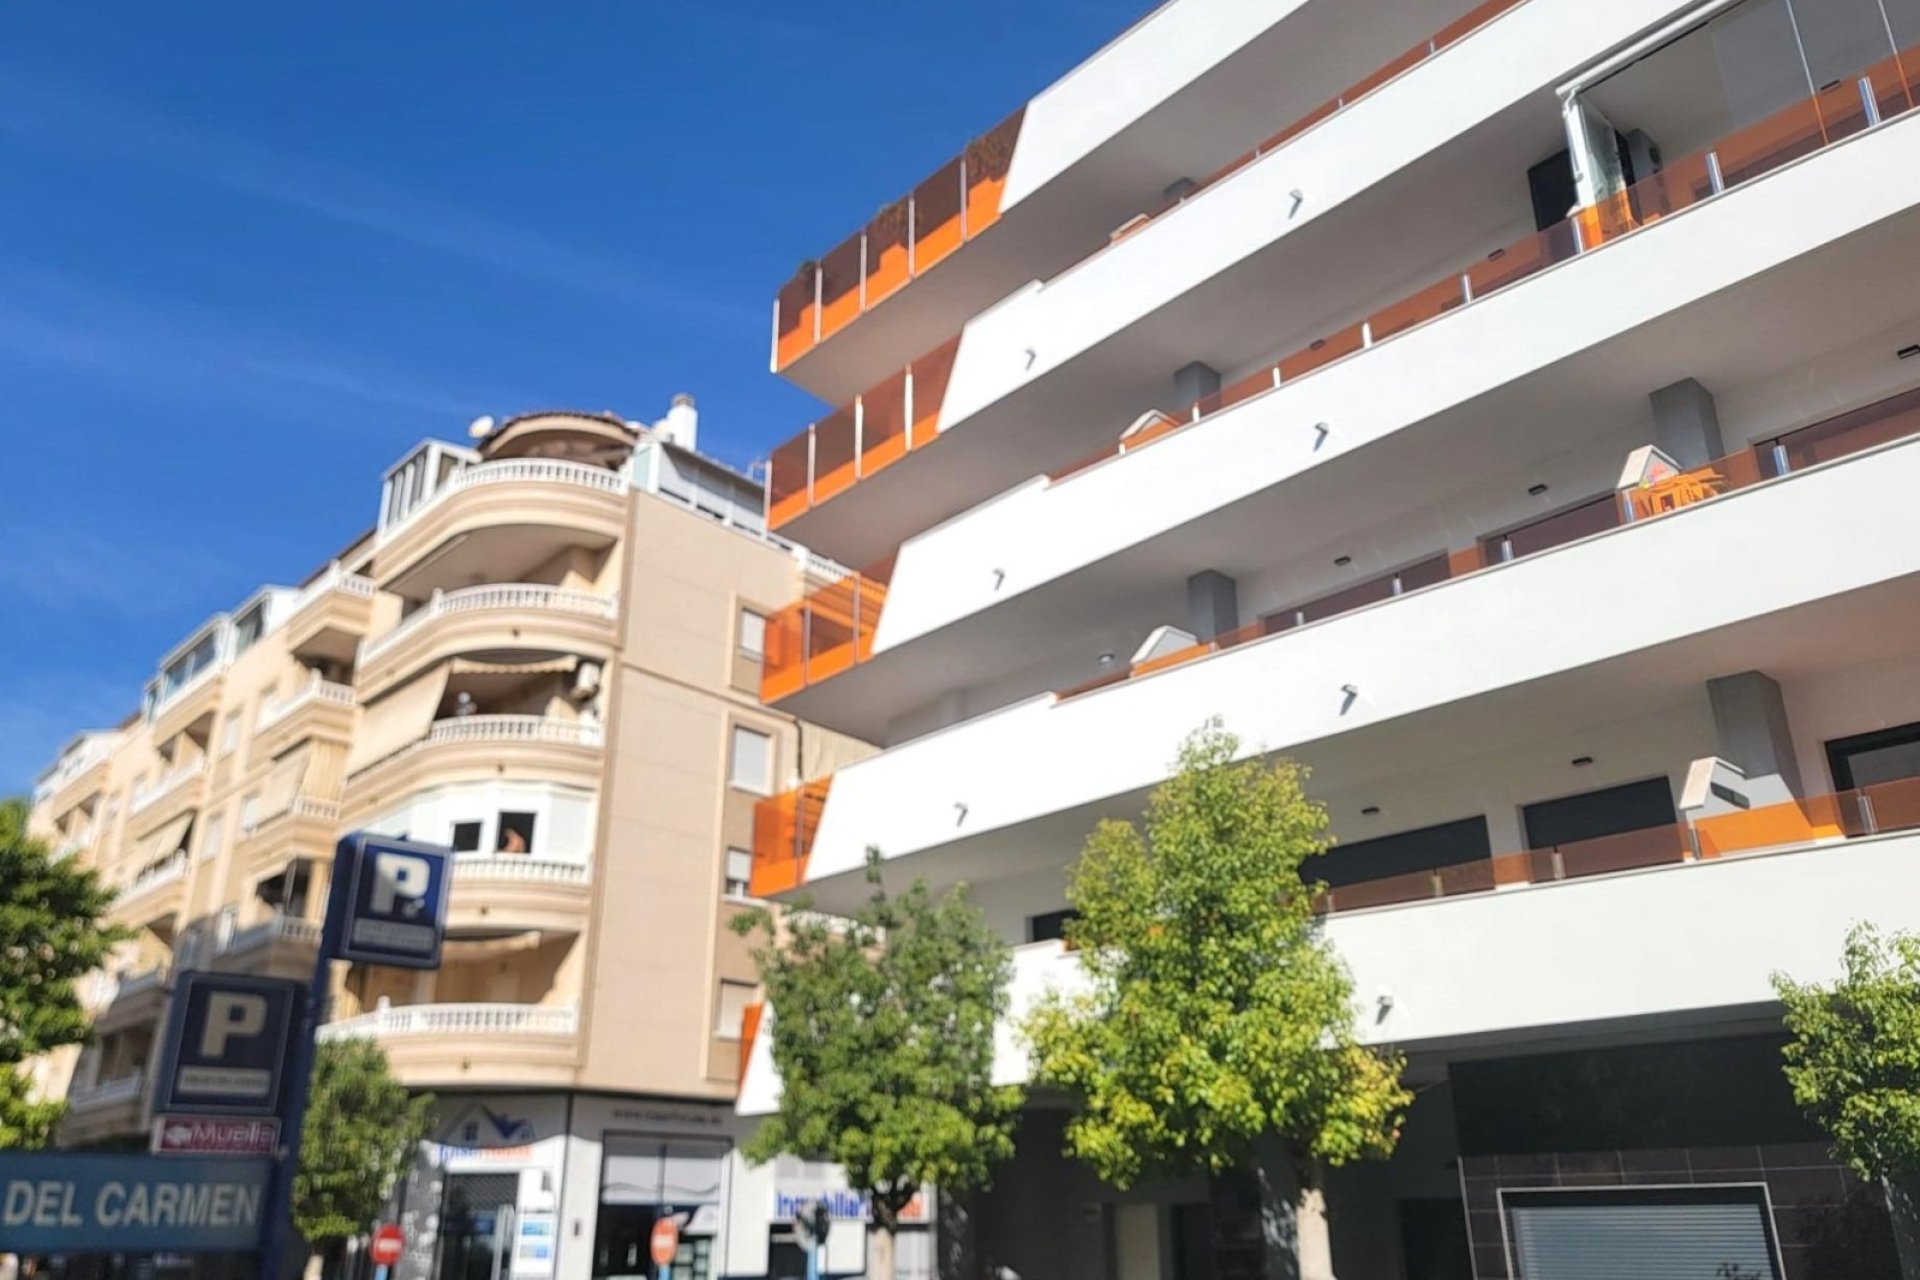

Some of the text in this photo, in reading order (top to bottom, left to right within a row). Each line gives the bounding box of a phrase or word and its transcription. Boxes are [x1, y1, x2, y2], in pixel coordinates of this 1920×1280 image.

[371, 851, 431, 914] P
[202, 991, 269, 1058] P
[4, 1179, 261, 1228] DEL CARMEN
